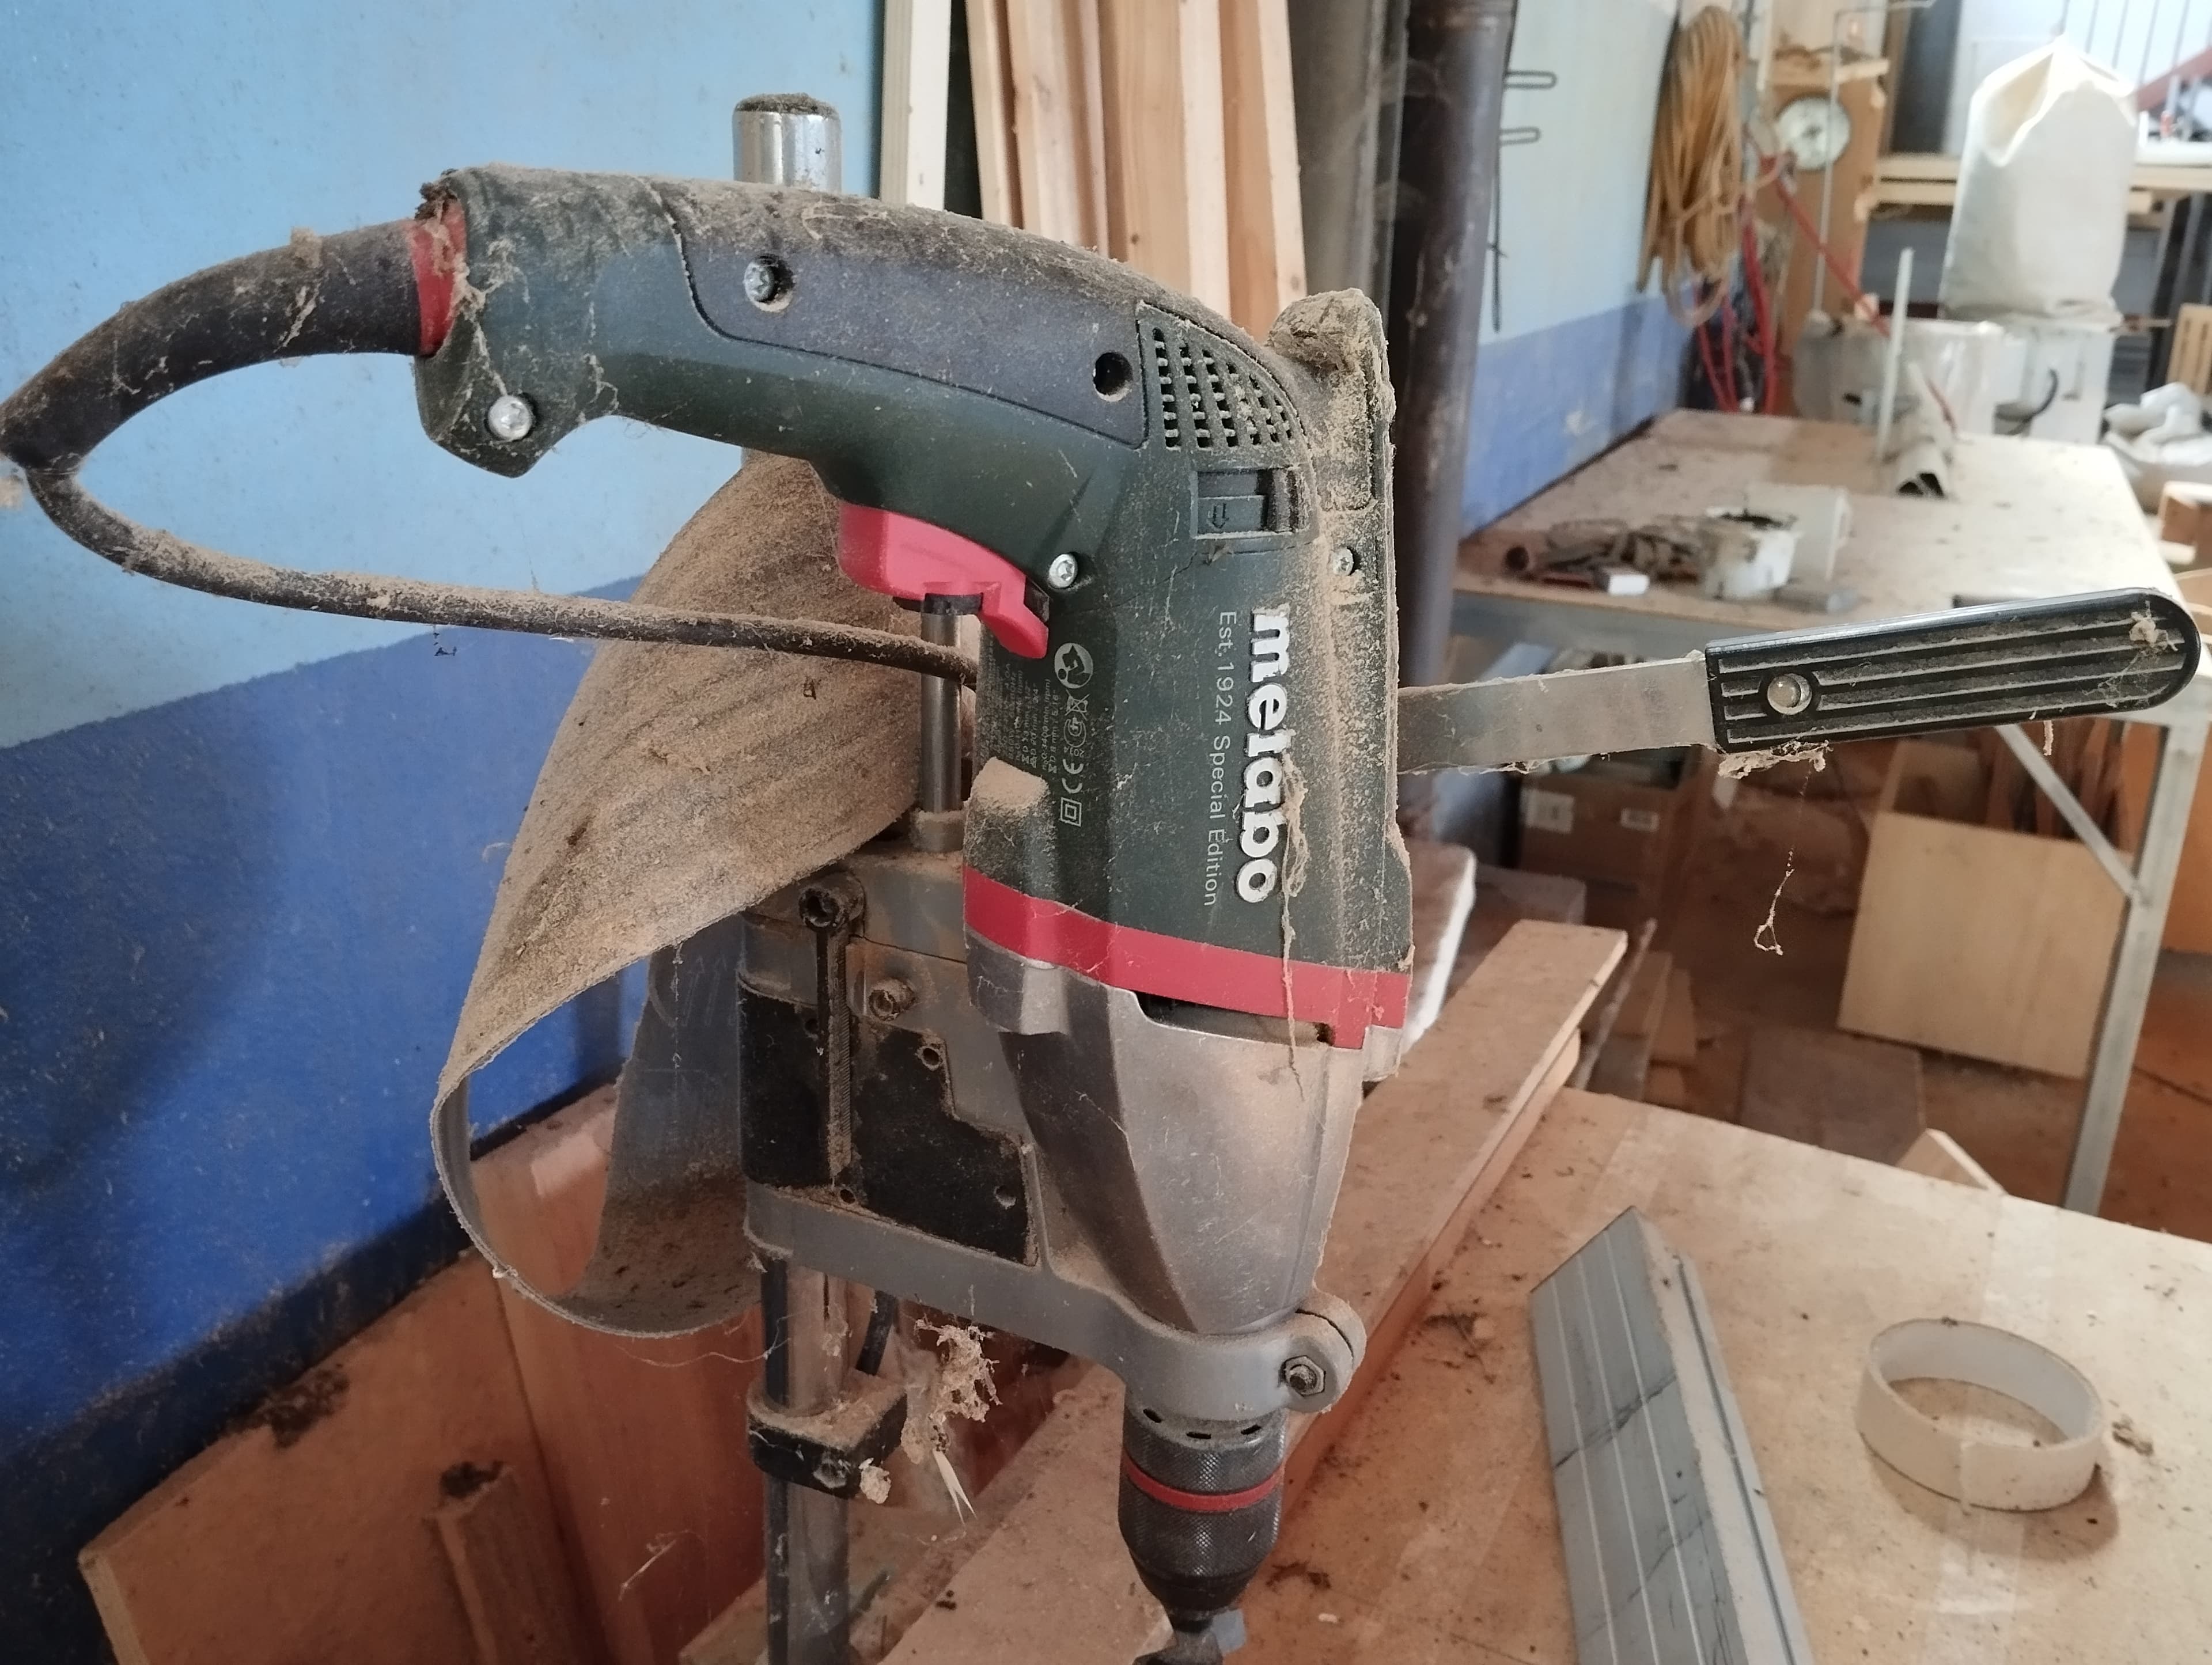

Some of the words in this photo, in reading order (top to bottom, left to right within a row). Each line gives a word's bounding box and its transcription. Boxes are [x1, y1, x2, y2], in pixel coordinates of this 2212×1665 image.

[1209, 735, 1231, 819] Special
[1236, 606, 1291, 903] metabo
[1204, 829, 1226, 906] Edition
